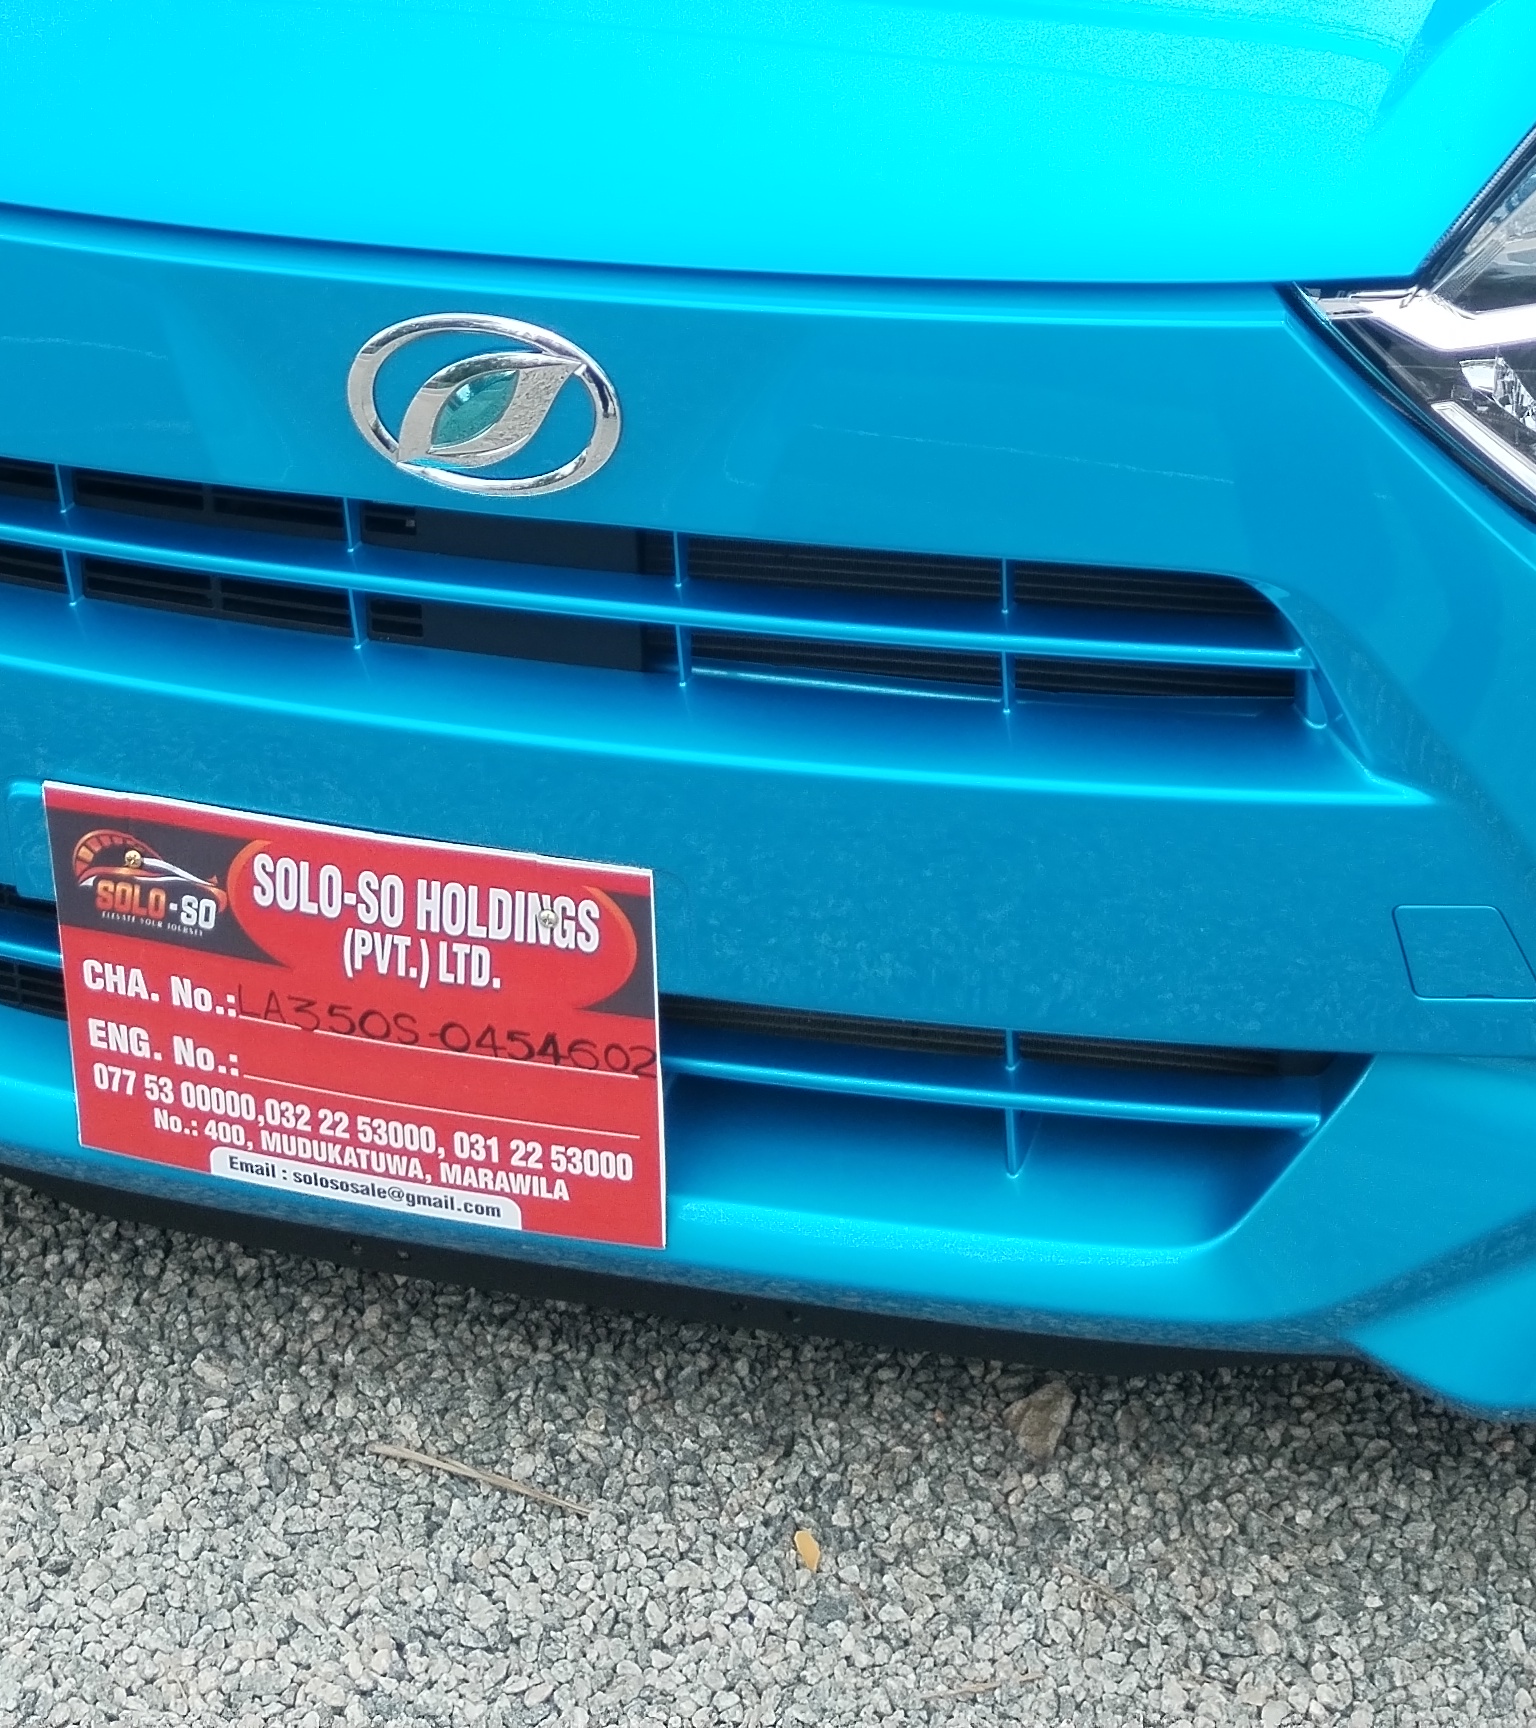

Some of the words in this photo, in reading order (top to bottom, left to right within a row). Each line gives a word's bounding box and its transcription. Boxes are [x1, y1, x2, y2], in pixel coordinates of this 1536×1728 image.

[252, 853, 405, 930] SOLO-SO
[416, 878, 601, 954] HOLDINGS
[82, 958, 161, 1003] CHA.
[343, 927, 430, 989] (PVT.)
[438, 940, 502, 989] LTD.
[88, 1018, 163, 1061] ENG.
[93, 1062, 136, 1096] 077
[144, 1074, 174, 1105] 53
[318, 1109, 350, 1139] 22
[356, 1116, 446, 1159] 53000,
[453, 1131, 500, 1163] 031
[510, 1139, 544, 1170] 22
[550, 1144, 633, 1181] 53000
[154, 1108, 199, 1137] No.:
[205, 1119, 253, 1150] 400,
[261, 1129, 432, 1184] MUDUKATUWA,
[440, 1162, 570, 1202] MARAWILA
[228, 1154, 277, 1180] Email
[292, 1169, 502, 1219] solososale@gmail.com
